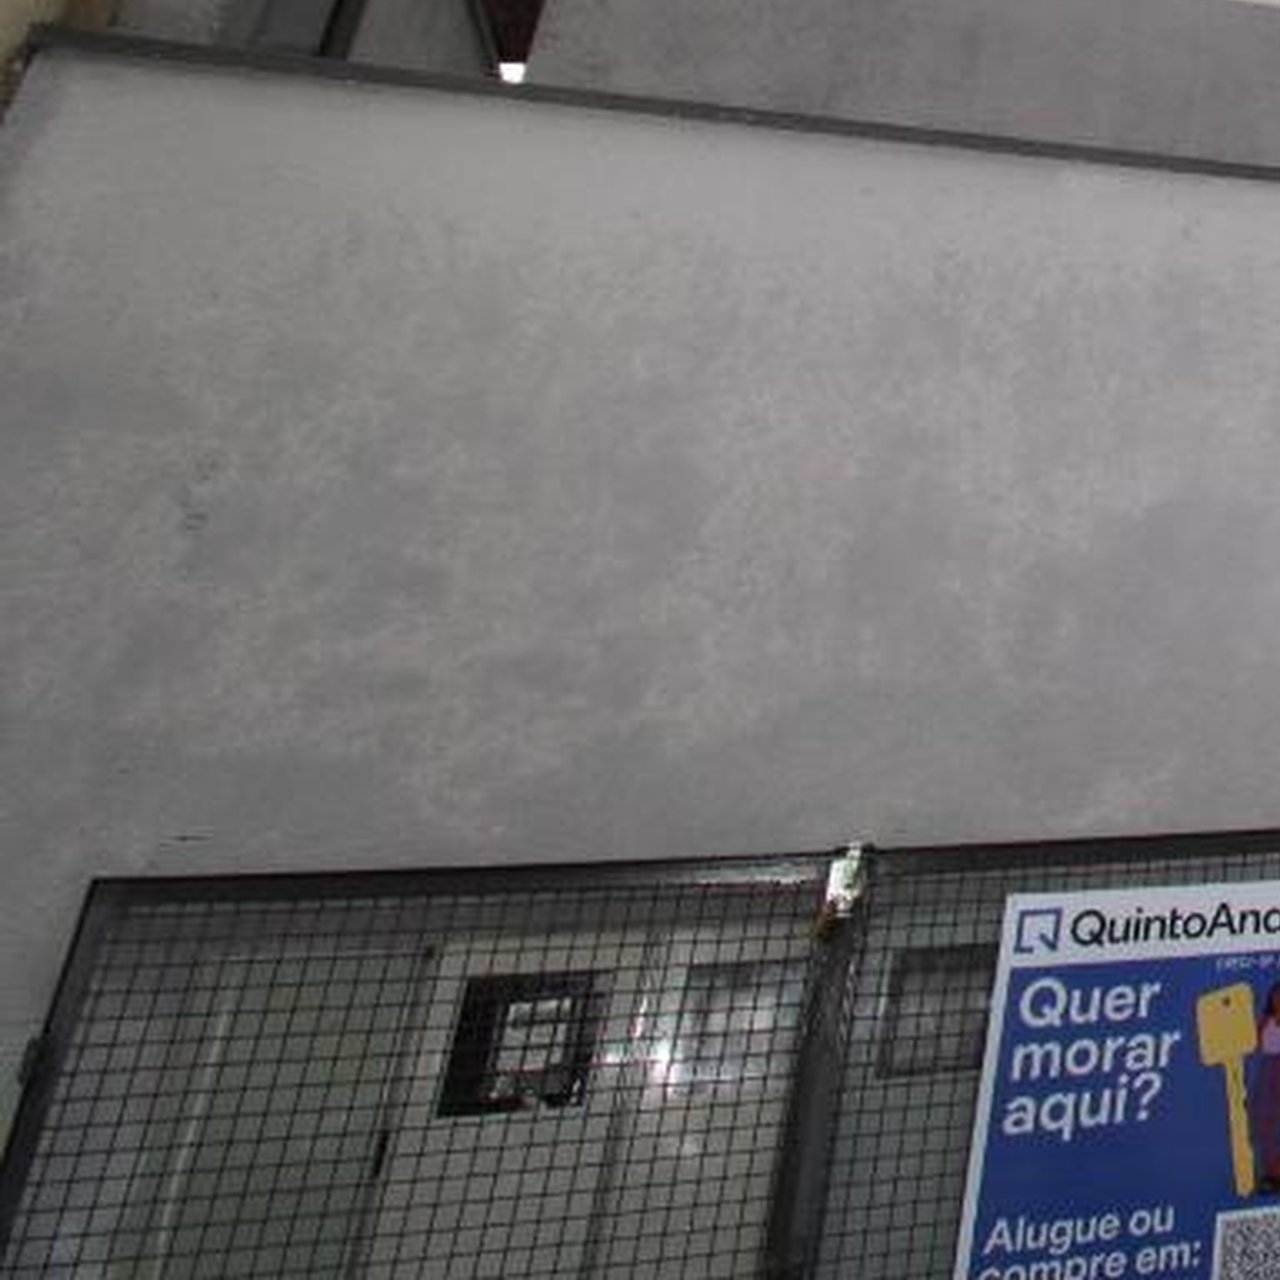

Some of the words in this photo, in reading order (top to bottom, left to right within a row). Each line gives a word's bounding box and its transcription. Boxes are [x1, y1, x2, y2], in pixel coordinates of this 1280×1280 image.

[1019, 978, 1161, 1028] Quer
[1011, 1031, 1180, 1081] morar
[1002, 1072, 1162, 1141] aqui?
[983, 1213, 1121, 1255] Alugue
[1128, 1206, 1174, 1236] ou
[1134, 1241, 1200, 1272] em:
